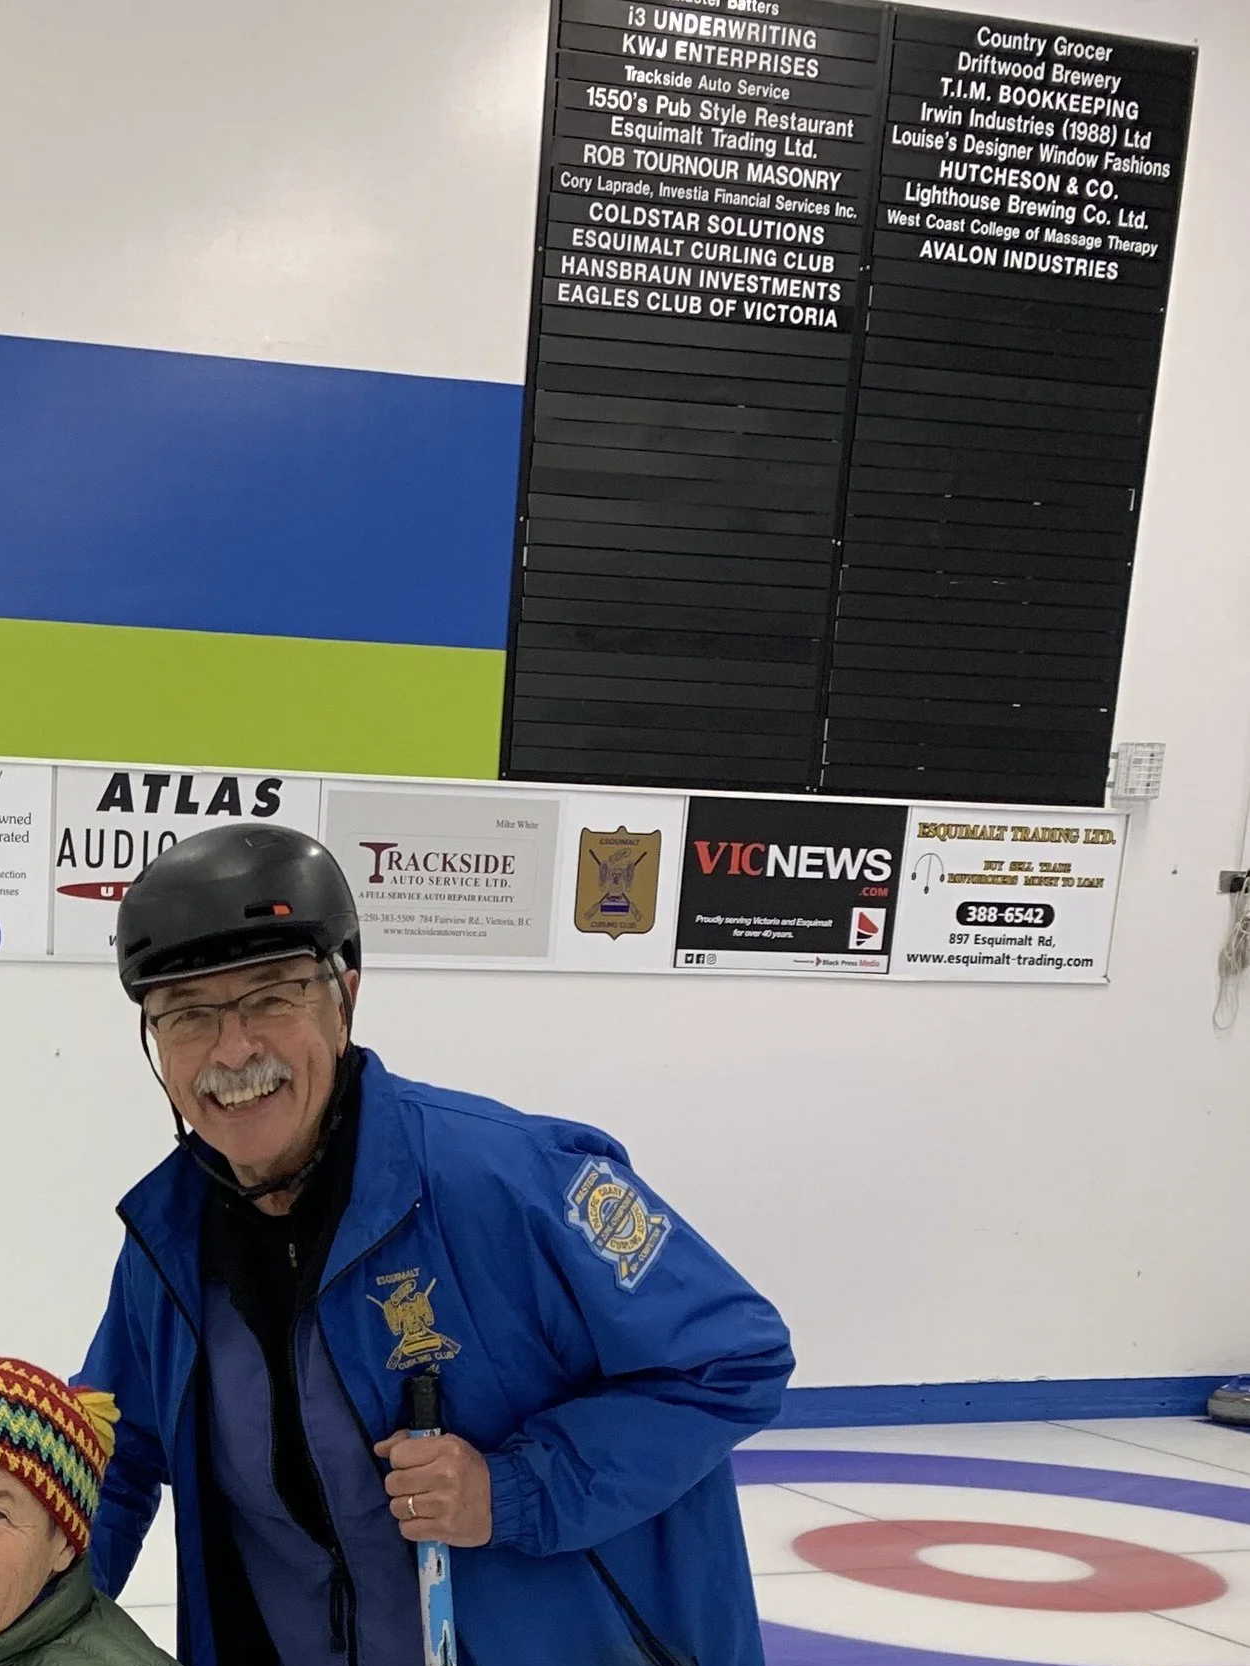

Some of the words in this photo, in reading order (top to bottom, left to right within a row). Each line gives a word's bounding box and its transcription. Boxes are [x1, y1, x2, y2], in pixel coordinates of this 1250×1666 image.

[628, 5, 646, 27] i3
[654, 10, 817, 50] UNDERWRITING
[727, 0, 780, 16] Batters
[622, 33, 668, 59] KWJ
[675, 41, 819, 78] ENTERPRISES
[976, 26, 1048, 59] Country
[1053, 35, 1114, 62] Grocer
[624, 64, 693, 89] Trackside
[697, 74, 732, 93] Auto
[737, 79, 790, 101] Service
[957, 51, 1046, 81] Driftwood
[1051, 63, 1122, 95] Brewery
[586, 86, 648, 114] 1550's
[655, 94, 692, 118] Pub
[699, 99, 747, 126] Style
[754, 106, 854, 138] Restaurant
[940, 76, 991, 102] T.I.M.
[998, 84, 1139, 121] BOOKKEEPING
[610, 115, 704, 146] Esquimalt
[711, 127, 777, 159] Trading
[784, 136, 818, 159] Ltd.
[920, 101, 963, 126] Irwin
[969, 107, 1055, 138] Industries
[1062, 117, 1118, 147] (1988)
[1123, 128, 1152, 150] Ltd
[583, 143, 625, 167] ROB
[632, 148, 739, 181] TOURNOUR
[746, 162, 842, 192] MASONRY
[891, 124, 958, 152] Louise's
[963, 133, 1034, 162] Designer
[1039, 142, 1099, 169] Window
[1103, 151, 1171, 178] Fashions
[560, 171, 593, 193] Cory
[597, 175, 654, 199] Laprade,
[658, 181, 709, 202] Investia
[714, 187, 771, 209] Financial
[774, 194, 831, 216] Services
[834, 201, 857, 219] Inc.
[939, 159, 1061, 193] HUTCHESON
[1066, 176, 1079, 195] &
[1085, 178, 1119, 200] CO.
[589, 201, 700, 232] COLDSTAR
[706, 214, 825, 246] SOLUTIONS
[905, 181, 1001, 212] Lighthouse
[1007, 194, 1077, 225] Brewing
[1082, 203, 1111, 226] Co.
[1117, 208, 1149, 230] Ltd.
[572, 227, 685, 257] ESQUIMALT
[690, 241, 777, 267] CURLING
[783, 251, 835, 273] CLUB
[887, 208, 921, 228] West
[925, 213, 966, 233] Coast
[970, 218, 1021, 241] College
[1025, 226, 1041, 241] of
[1043, 227, 1103, 251] Massage
[1107, 234, 1159, 258] Therapy
[561, 255, 692, 287] HANSBRAUN
[698, 269, 841, 302] INVESTMENTS
[919, 239, 998, 266] AVALON
[1003, 249, 1119, 280] INDUSTRIES
[557, 282, 640, 309] EAGLES
[646, 291, 702, 315] CLUB
[709, 297, 737, 318] OF
[743, 300, 838, 328] VICTORIA
[95, 771, 283, 818] ATLAS
[495, 819, 516, 829] Mike
[517, 820, 539, 830] White
[916, 822, 1009, 843] ESQUIMALT
[1010, 825, 1080, 844] TRADING
[1082, 828, 1117, 845] LTD.
[359, 842, 515, 883] TRACKSIDE
[392, 875, 425, 885] AUTO
[428, 876, 480, 888] SERVICE
[485, 877, 508, 888] LTD.
[365, 891, 385, 899] FULL
[387, 892, 421, 900] SERVICE
[424, 893, 446, 901] AUTO
[446, 893, 476, 902] REPAIR
[477, 894, 514, 904] FACILITY
[966, 905, 1045, 924] 388-6542
[434, 915, 466, 925] Fairview
[695, 914, 725, 925] Proudly
[724, 916, 753, 927] serving
[752, 916, 781, 926] Victoria
[780, 917, 797, 926] and
[795, 917, 834, 928] Esquimalt
[732, 928, 745, 937] for
[744, 930, 762, 938] over
[948, 932, 970, 945] 897
[973, 933, 1033, 948] Esquimalt
[1037, 935, 1056, 949] Rd,
[906, 951, 1094, 970] www.esquimalt-trading.com
